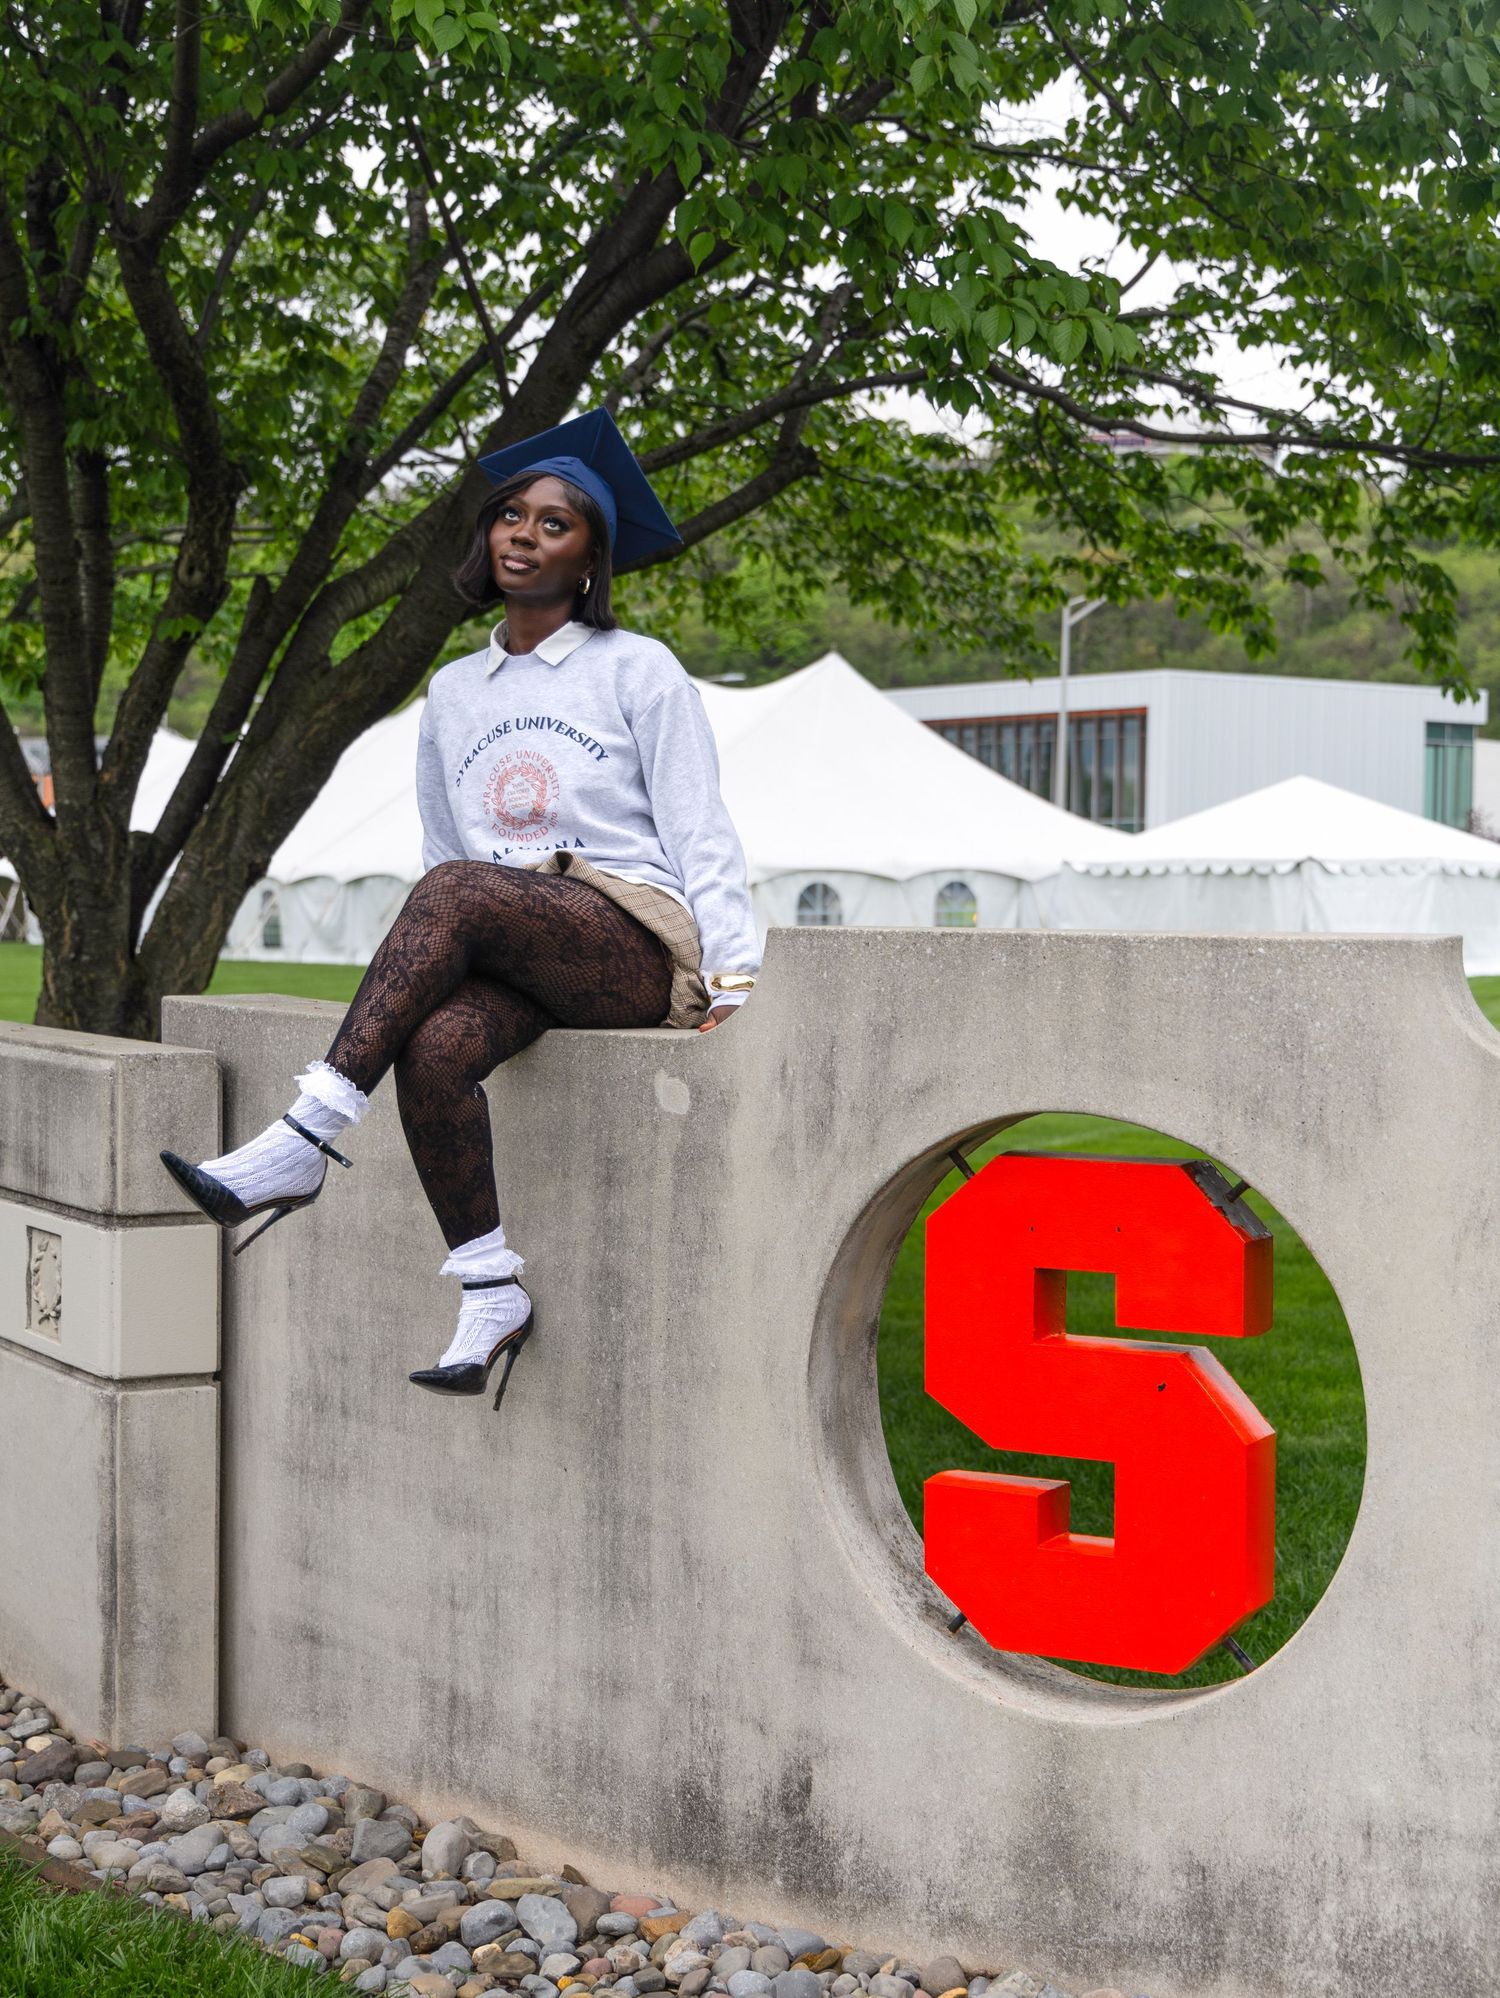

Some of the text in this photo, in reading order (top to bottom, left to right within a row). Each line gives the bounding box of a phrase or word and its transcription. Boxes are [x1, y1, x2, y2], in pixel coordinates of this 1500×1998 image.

[456, 716, 609, 788] SYRACUSE UNIVERSITY
[482, 750, 560, 815] SYRACUSE UNIVERSITY
[491, 823, 549, 842] FOUNDED
[924, 1150, 1275, 1675] S
